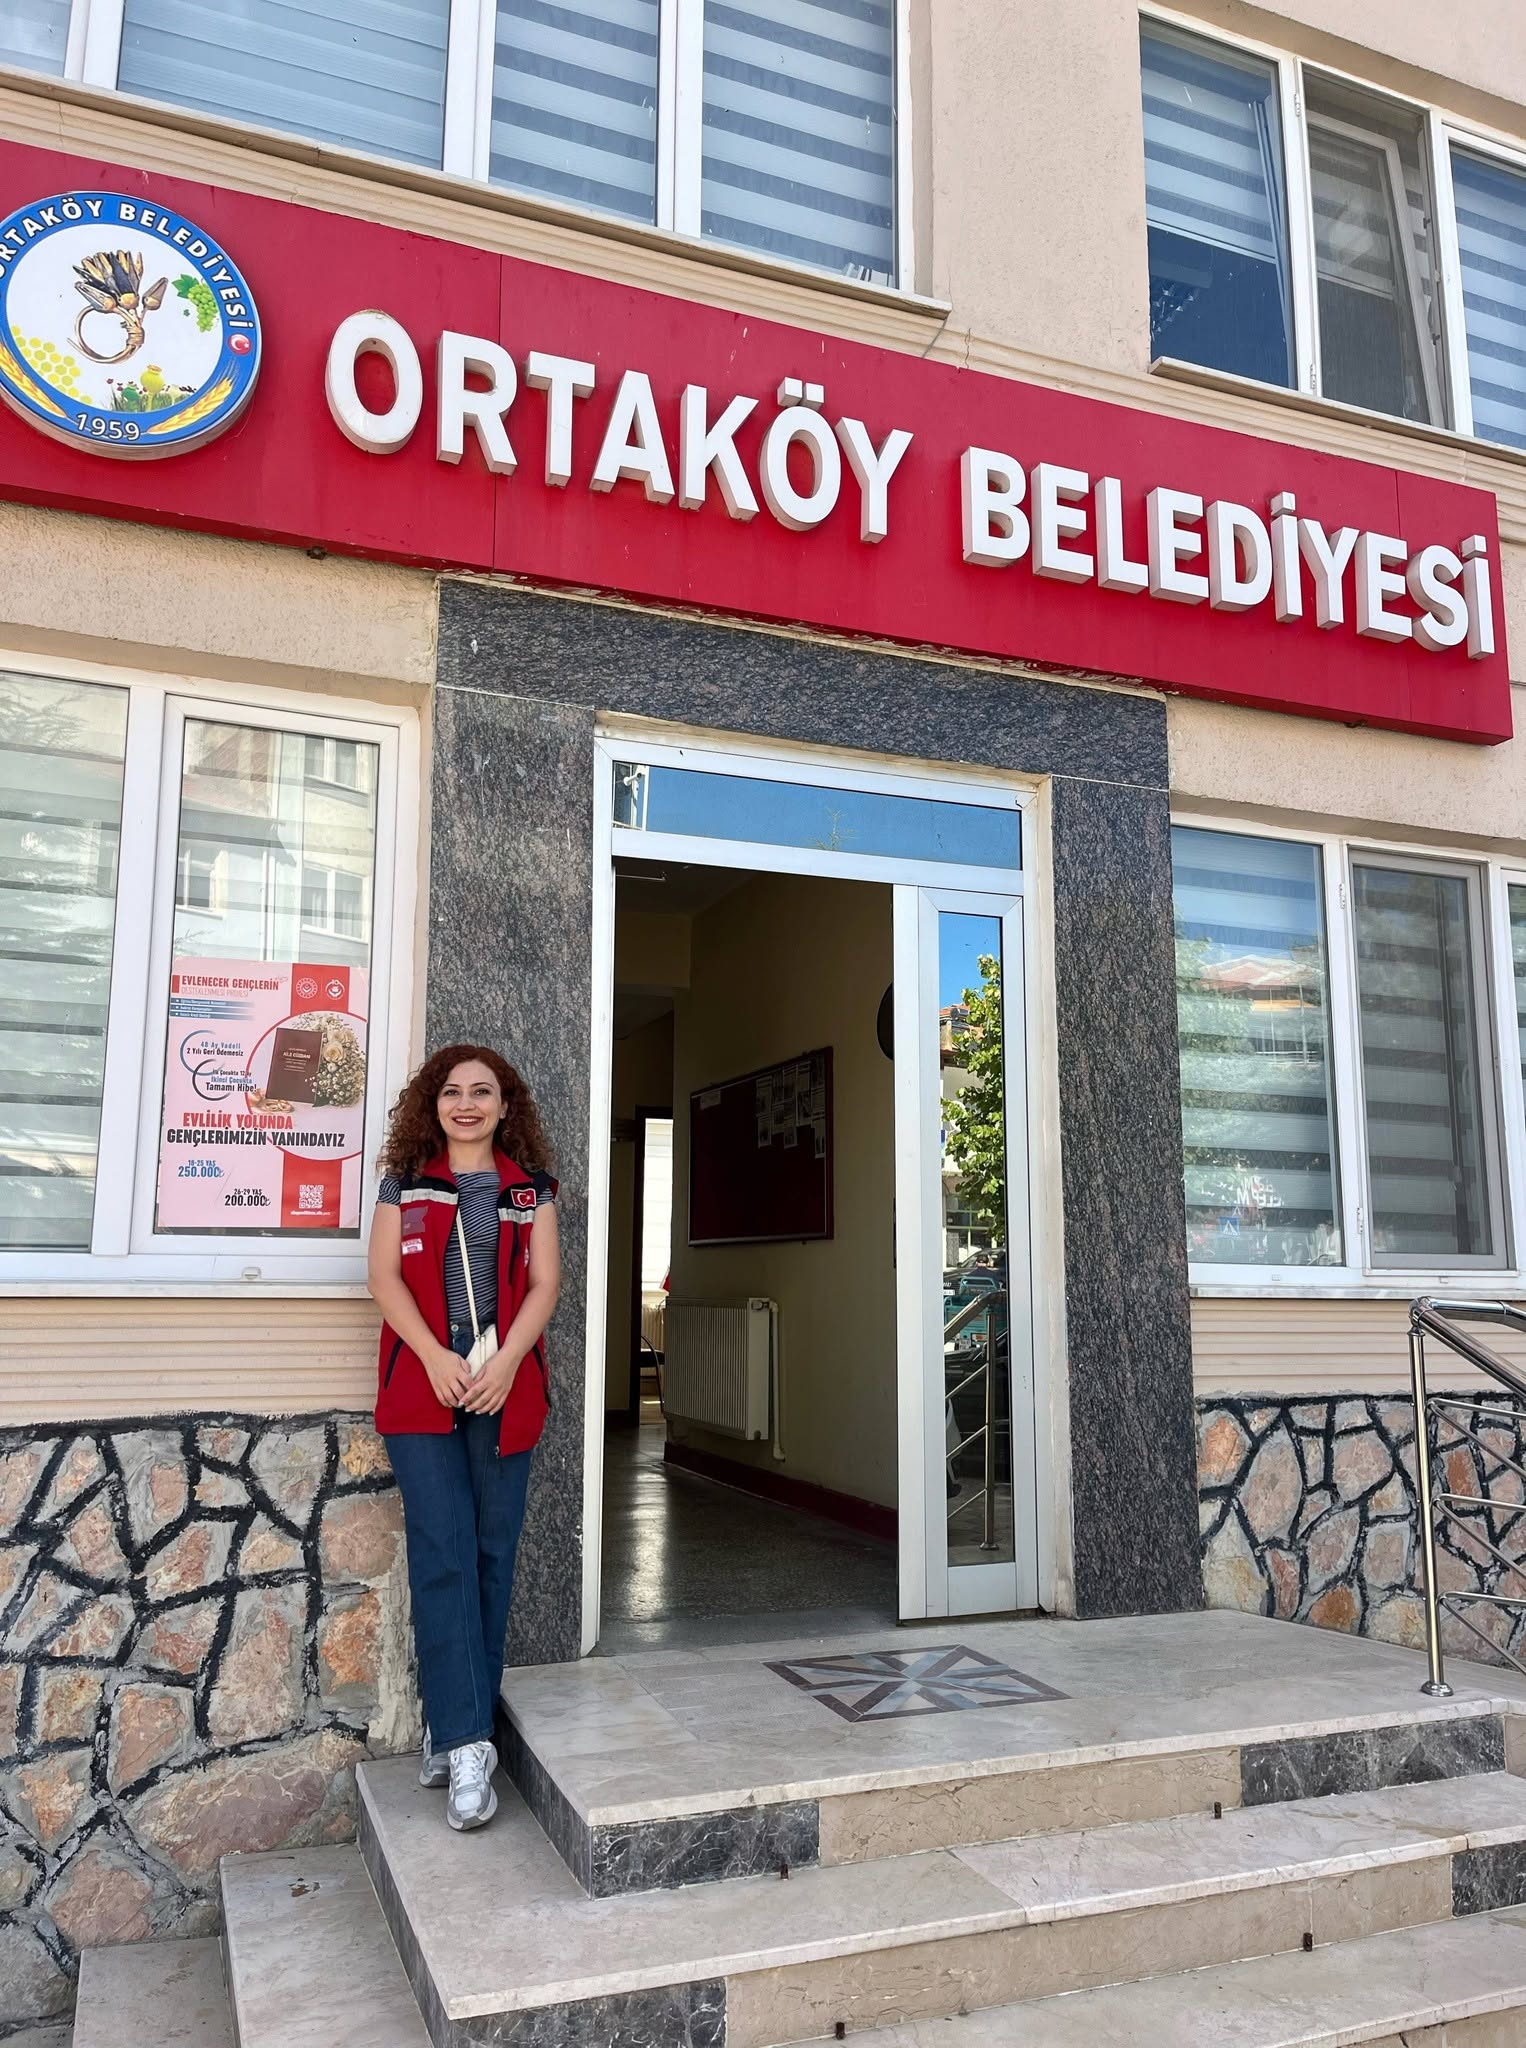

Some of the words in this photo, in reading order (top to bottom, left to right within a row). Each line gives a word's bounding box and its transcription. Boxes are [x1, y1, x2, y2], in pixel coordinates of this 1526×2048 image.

[119, 203, 255, 329] BELEDİYESİ
[75, 413, 141, 441] 1959
[325, 308, 914, 544] ORTAKÖY
[960, 445, 1495, 660] BELEDİYESİ
[182, 975, 229, 988] EVLENECEK
[232, 978, 279, 991] GENÇLERİN
[216, 1048, 244, 1057] Ödemesiz
[205, 1082, 235, 1092] Tamamı
[237, 1083, 257, 1092] Hibe!
[183, 1109, 232, 1128] EVLİLİK
[236, 1114, 293, 1130] YOLUNDA
[166, 1127, 267, 1148] GENÇLERİMİZİN
[272, 1131, 345, 1148] YANINDAYIZ
[188, 1159, 204, 1167] 18-25
[205, 1160, 216, 1168] YAŞ
[234, 1188, 251, 1196] 26-29
[252, 1188, 263, 1197] YAŞ
